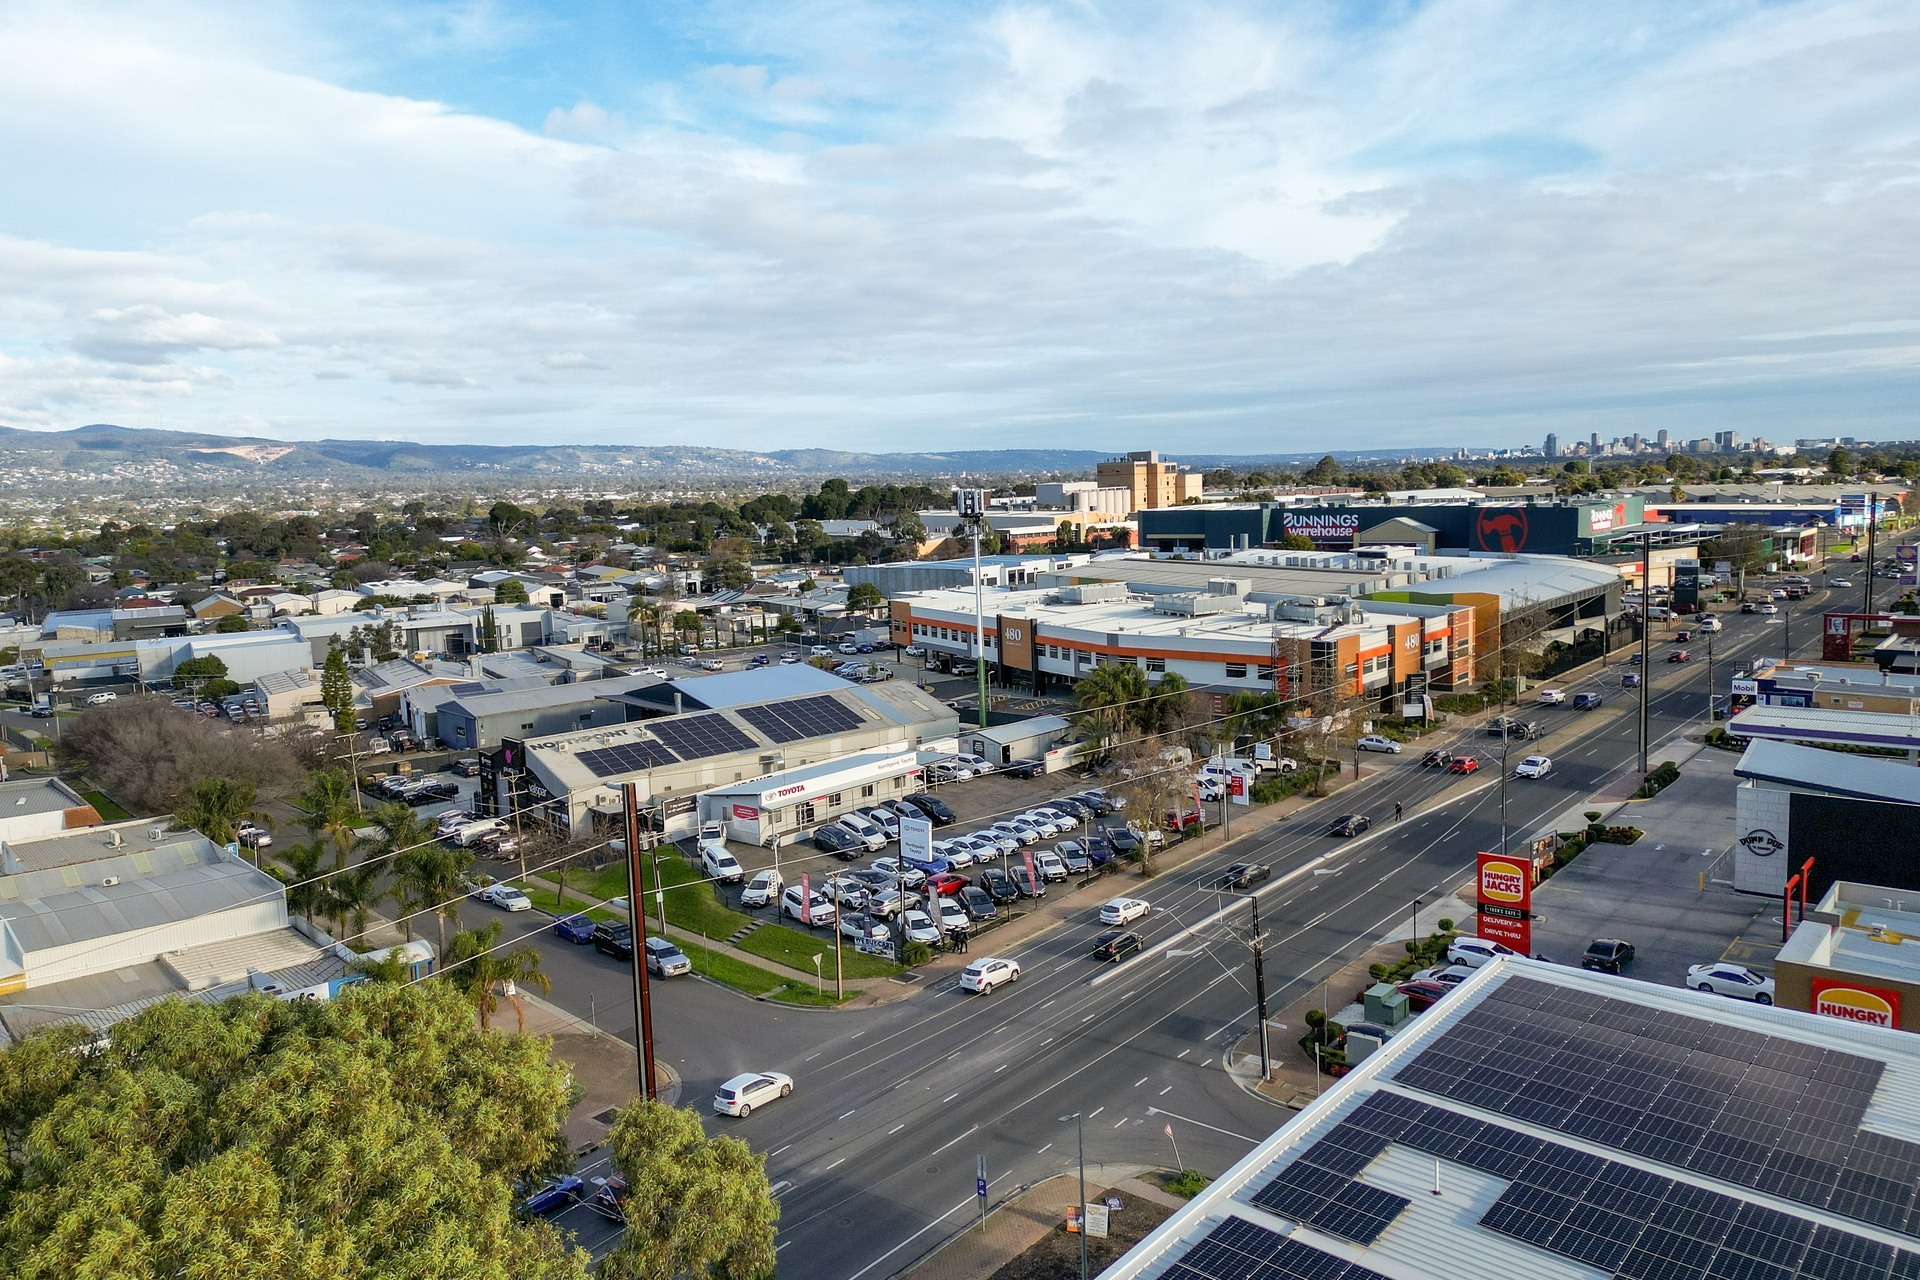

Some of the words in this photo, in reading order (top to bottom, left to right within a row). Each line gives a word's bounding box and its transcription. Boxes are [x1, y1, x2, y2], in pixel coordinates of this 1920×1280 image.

[1283, 512, 1359, 527] BUNNINGS
[1288, 523, 1353, 537] warehouse
[1005, 627, 1022, 641] 480
[1405, 634, 1420, 649] 480
[1733, 684, 1755, 692] Mobil
[777, 784, 806, 798] TOYOTA
[1739, 836, 1764, 846] DOWN
[1766, 838, 1786, 850] DOG
[1484, 871, 1521, 884] HUNGRY
[1484, 880, 1521, 894] JACK'S
[1483, 916, 1513, 927] DELIVERY
[1484, 927, 1503, 937] DRIVE
[1503, 931, 1521, 940] THRU
[856, 936, 865, 945] WE
[866, 938, 877, 947] BUY
[1820, 1003, 1888, 1025] HUNGRY
